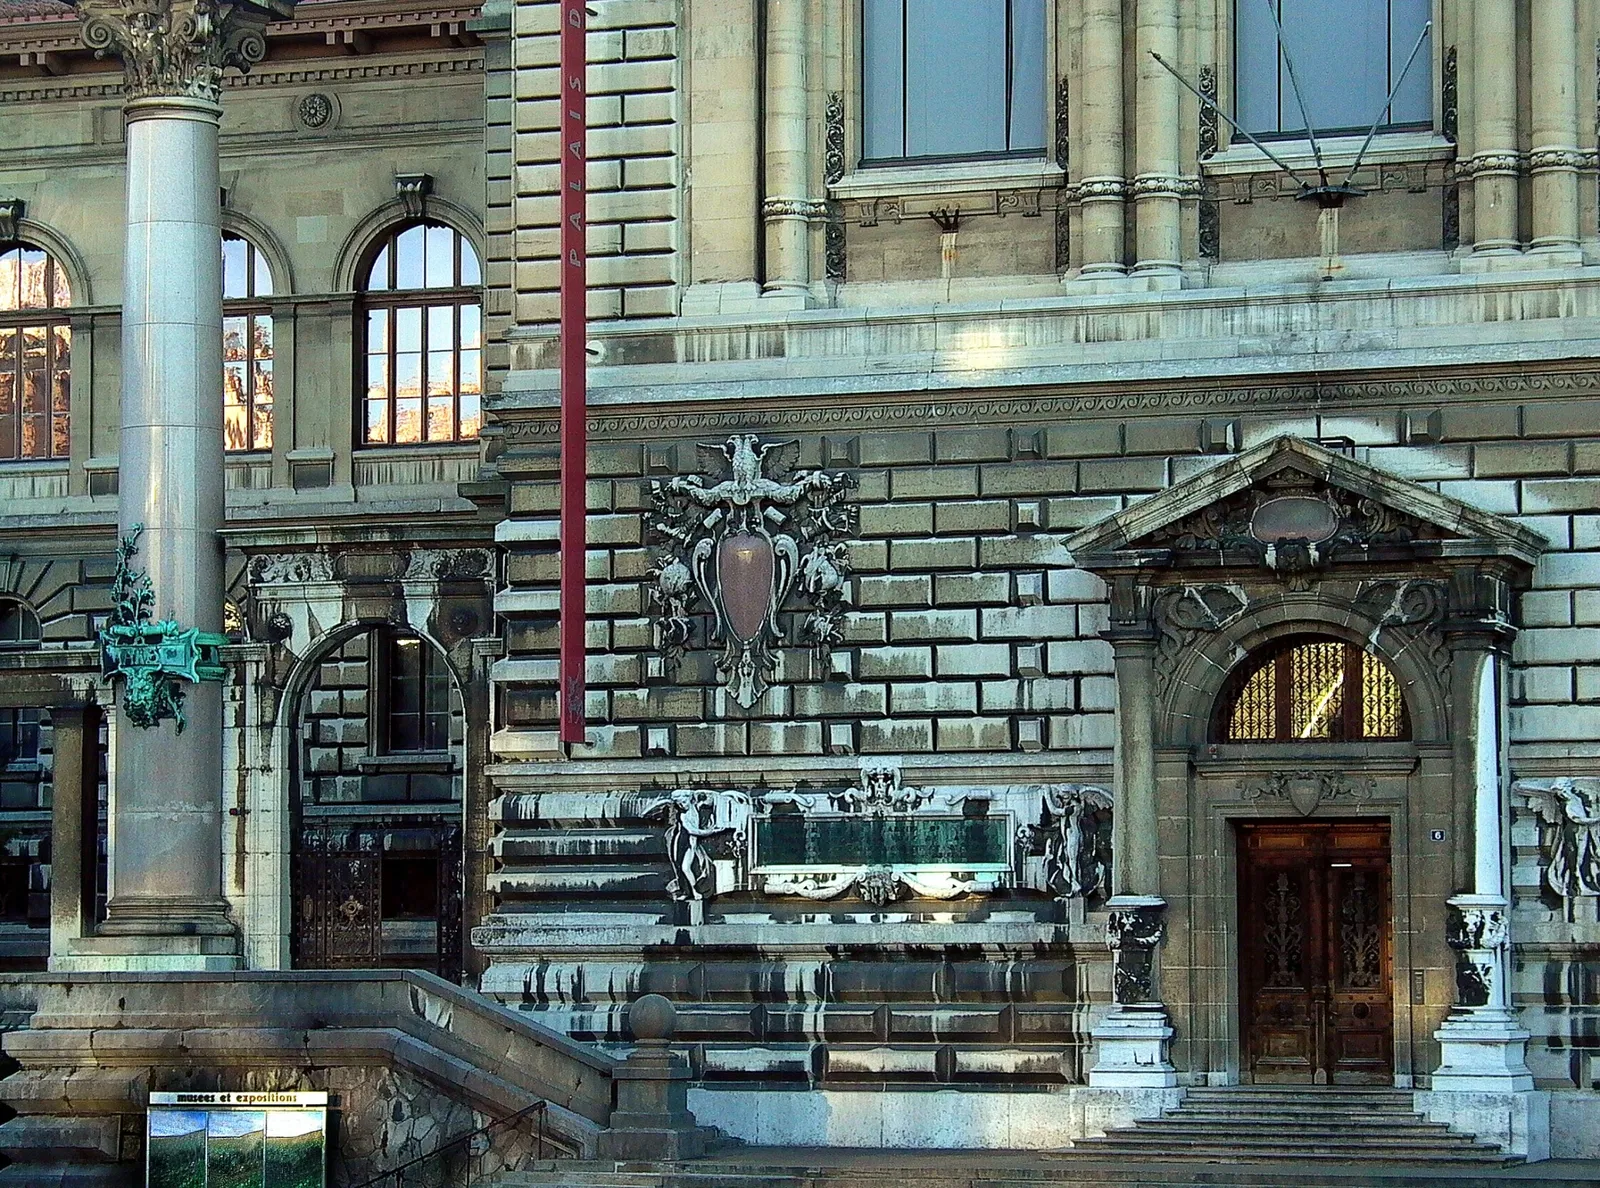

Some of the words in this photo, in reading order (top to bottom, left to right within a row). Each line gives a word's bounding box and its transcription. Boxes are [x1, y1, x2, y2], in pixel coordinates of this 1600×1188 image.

[569, 75, 582, 267] PALAIS
[1434, 831, 1442, 840] 6
[219, 1092, 231, 1103] et
[236, 1090, 297, 1105] expositions
